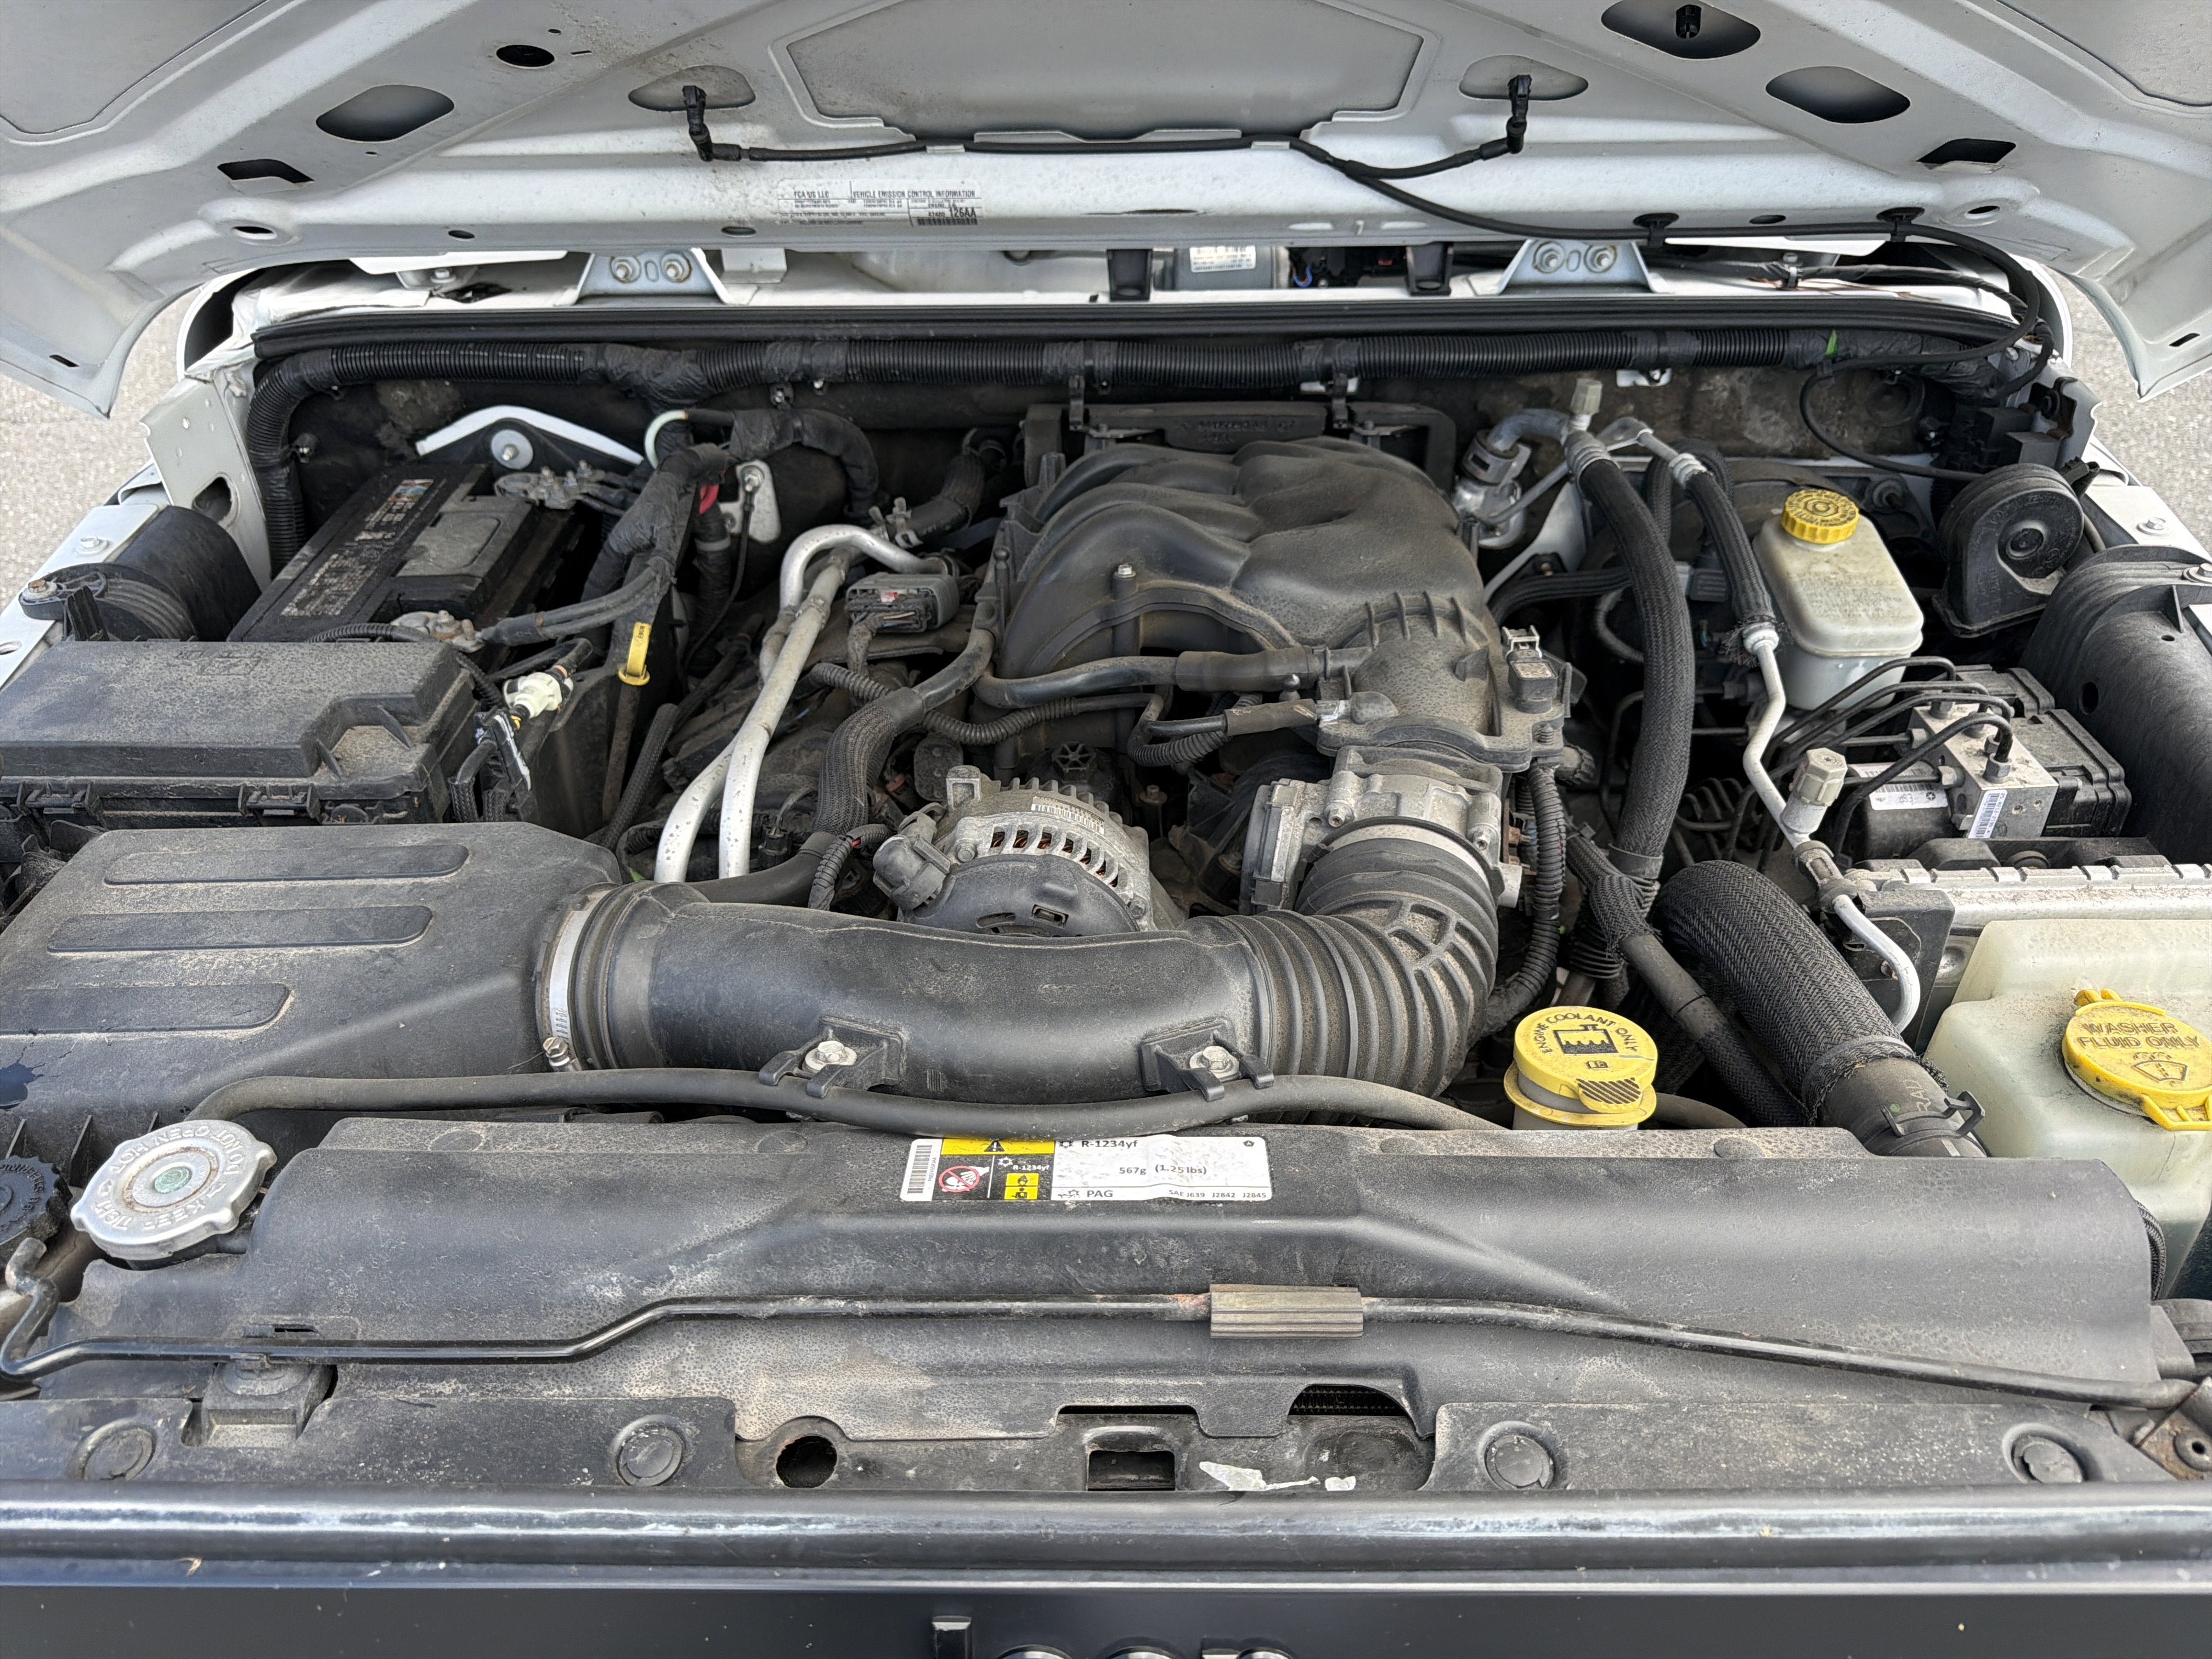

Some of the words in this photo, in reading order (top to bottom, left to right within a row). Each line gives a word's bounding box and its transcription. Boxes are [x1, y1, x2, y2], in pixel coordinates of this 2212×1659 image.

[949, 207, 977, 218] 126AA
[1534, 1023, 1553, 1054] ENGINE
[1545, 1013, 1616, 1027] COOLANT
[1615, 1027, 1638, 1052] ONLY
[2082, 1022, 2179, 1034] WASHER
[2078, 1036, 2141, 1048] FLUID
[2146, 1036, 2200, 1048] ONLY
[153, 1125, 212, 1147] OPEN
[211, 1129, 245, 1154] NOT
[1081, 1140, 1138, 1149] R-1234yf
[111, 1143, 150, 1175] HOT
[223, 1154, 245, 1176] DO
[1119, 1167, 1147, 1175] 567g
[1155, 1164, 1184, 1173] (1.25
[1187, 1166, 1207, 1175] lbs)
